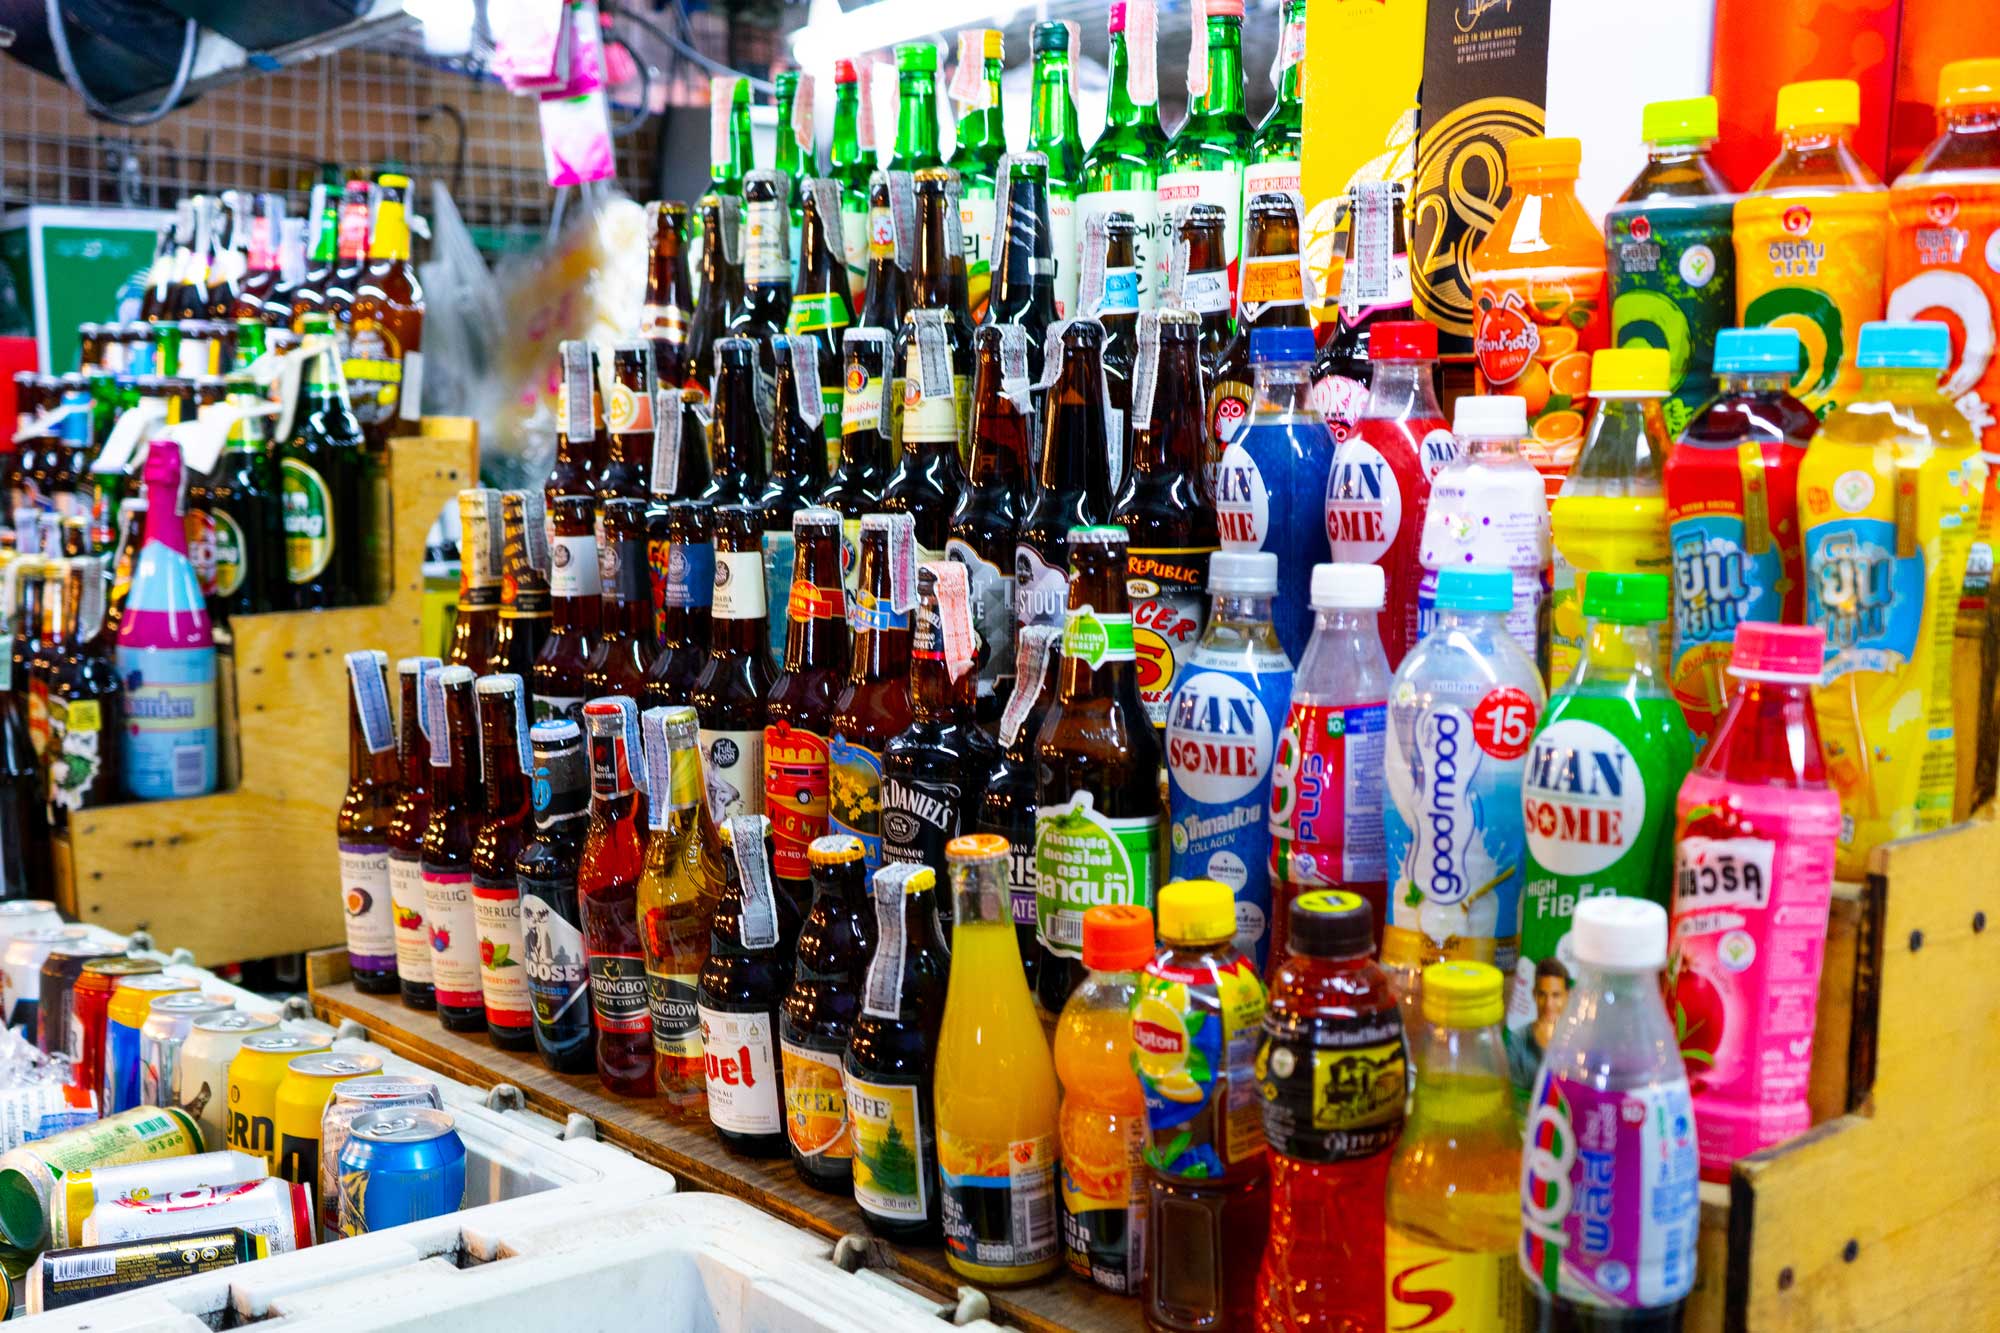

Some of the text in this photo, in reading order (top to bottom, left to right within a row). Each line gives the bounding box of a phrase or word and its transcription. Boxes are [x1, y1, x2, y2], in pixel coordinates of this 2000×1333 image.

[1329, 511, 1386, 543] OME
[1128, 556, 1200, 584] REPUBLIC
[1018, 588, 1068, 616] STOUT
[1172, 690, 1256, 735] MAN
[1486, 705, 1527, 746] 15
[1169, 737, 1258, 778] SOME
[1527, 744, 1626, 797] MAN
[1298, 752, 1326, 844] PLUS
[1428, 713, 1461, 896] goodmood
[1524, 799, 1624, 848] SOME
[1189, 833, 1237, 856] COLLAGEN
[1057, 864, 1089, 880] ตรา
[1528, 881, 1558, 897] HIGH
[528, 964, 580, 982] OOSE
[661, 1018, 689, 1028] CIDERS
[663, 1043, 687, 1054] Apple
[1134, 1024, 1179, 1051] Lipton
